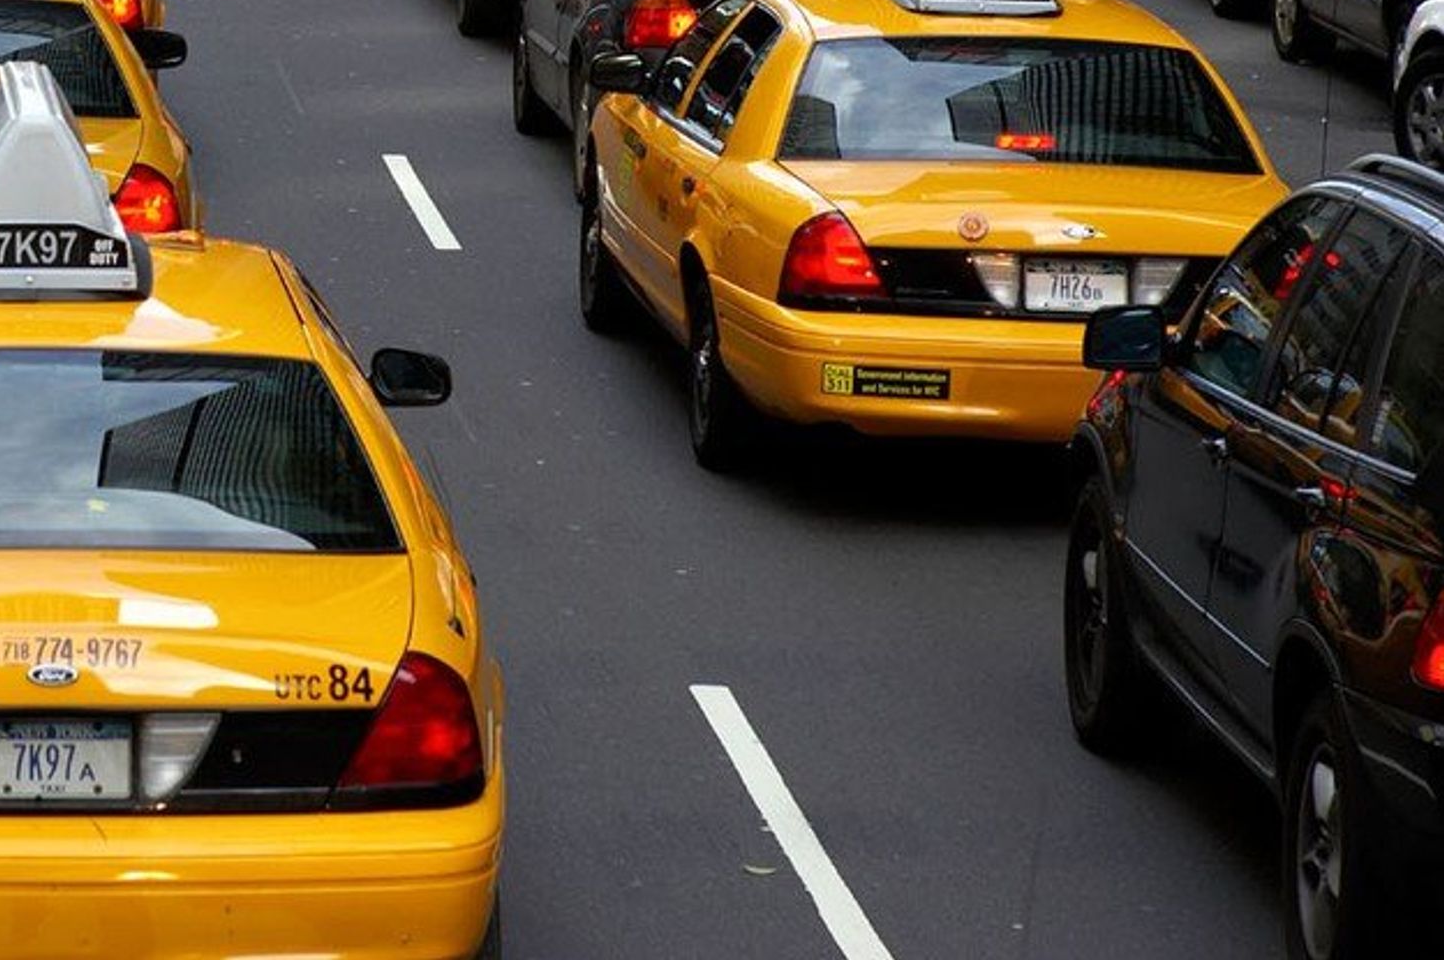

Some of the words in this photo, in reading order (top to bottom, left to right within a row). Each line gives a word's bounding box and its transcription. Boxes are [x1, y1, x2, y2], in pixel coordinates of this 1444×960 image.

[95, 239, 114, 252] OFF
[89, 252, 119, 265] DUTY
[2, 642, 30, 660] 718
[34, 637, 143, 668] 774-9767
[275, 673, 322, 701] UTC
[328, 663, 374, 702] 84
